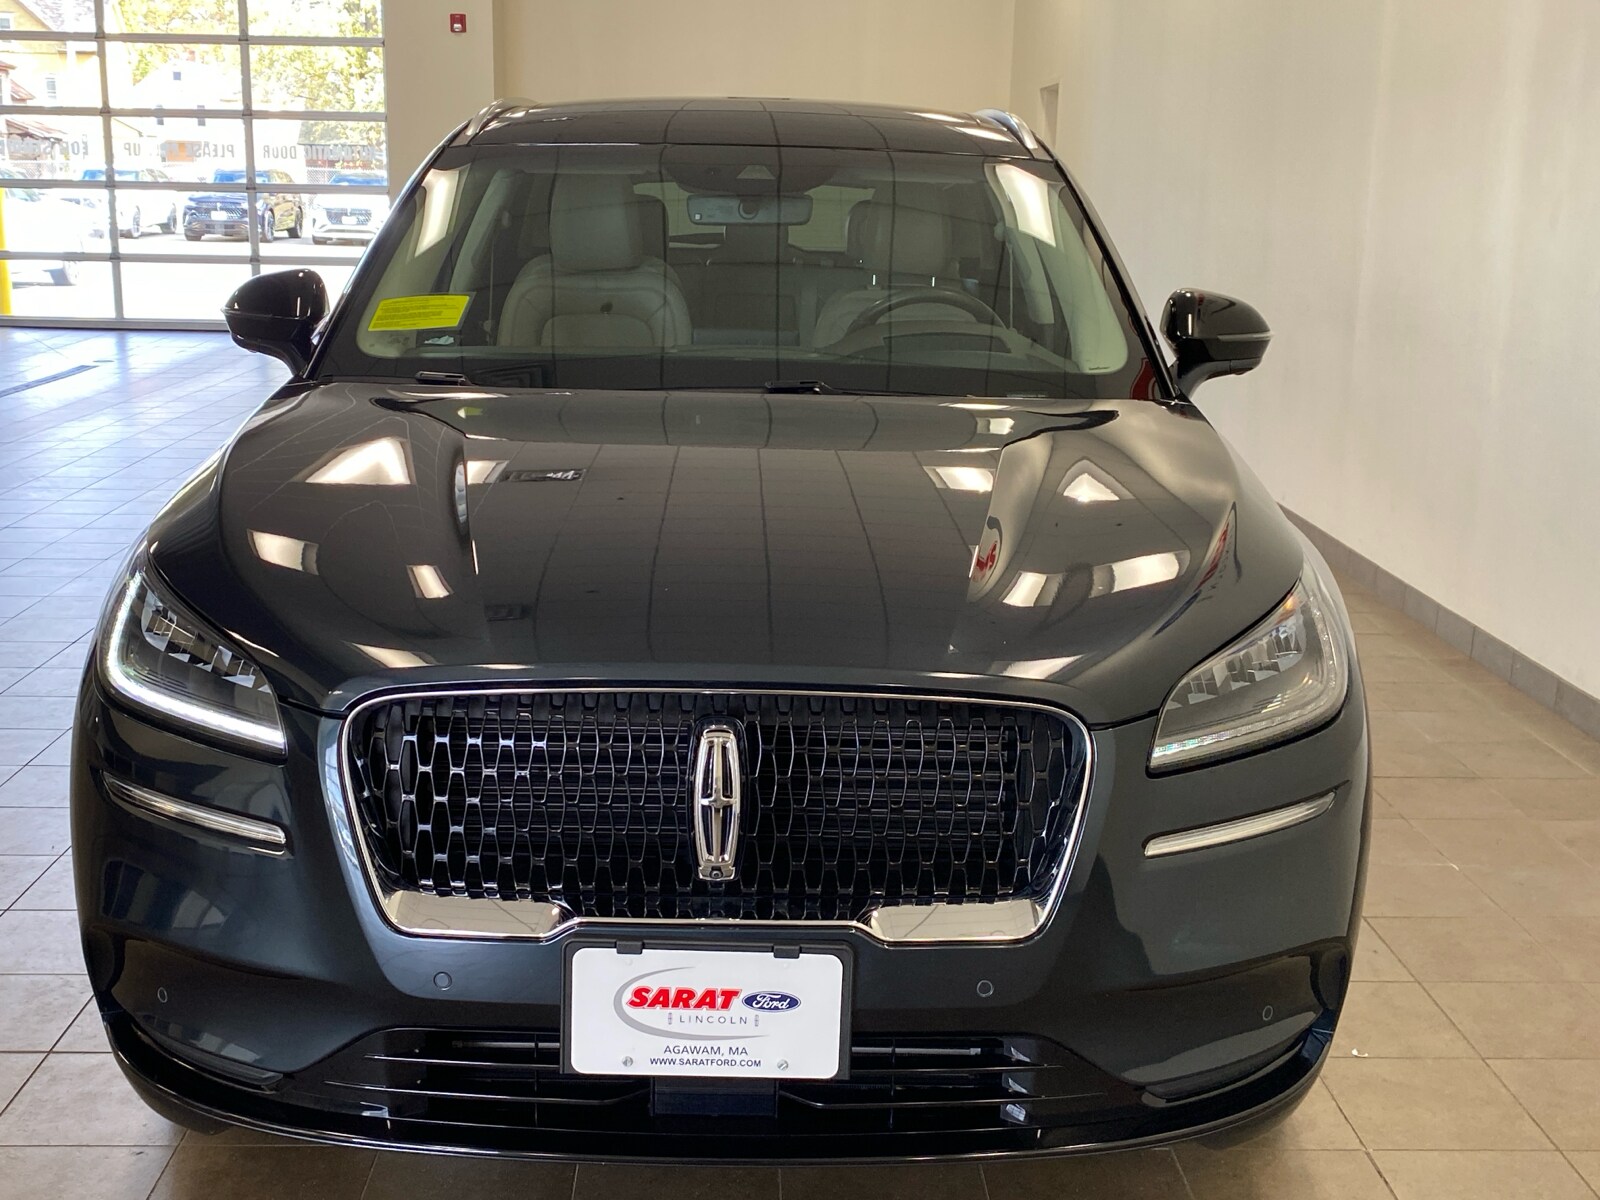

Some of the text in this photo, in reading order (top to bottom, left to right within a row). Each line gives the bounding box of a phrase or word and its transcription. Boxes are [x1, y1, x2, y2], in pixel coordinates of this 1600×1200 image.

[627, 986, 792, 1011] SARAT Ford
[679, 1014, 748, 1025] LINCOLN
[663, 1045, 749, 1057] AGAWAM, MA
[649, 1057, 762, 1068] WWW.SARATFORD.COM
